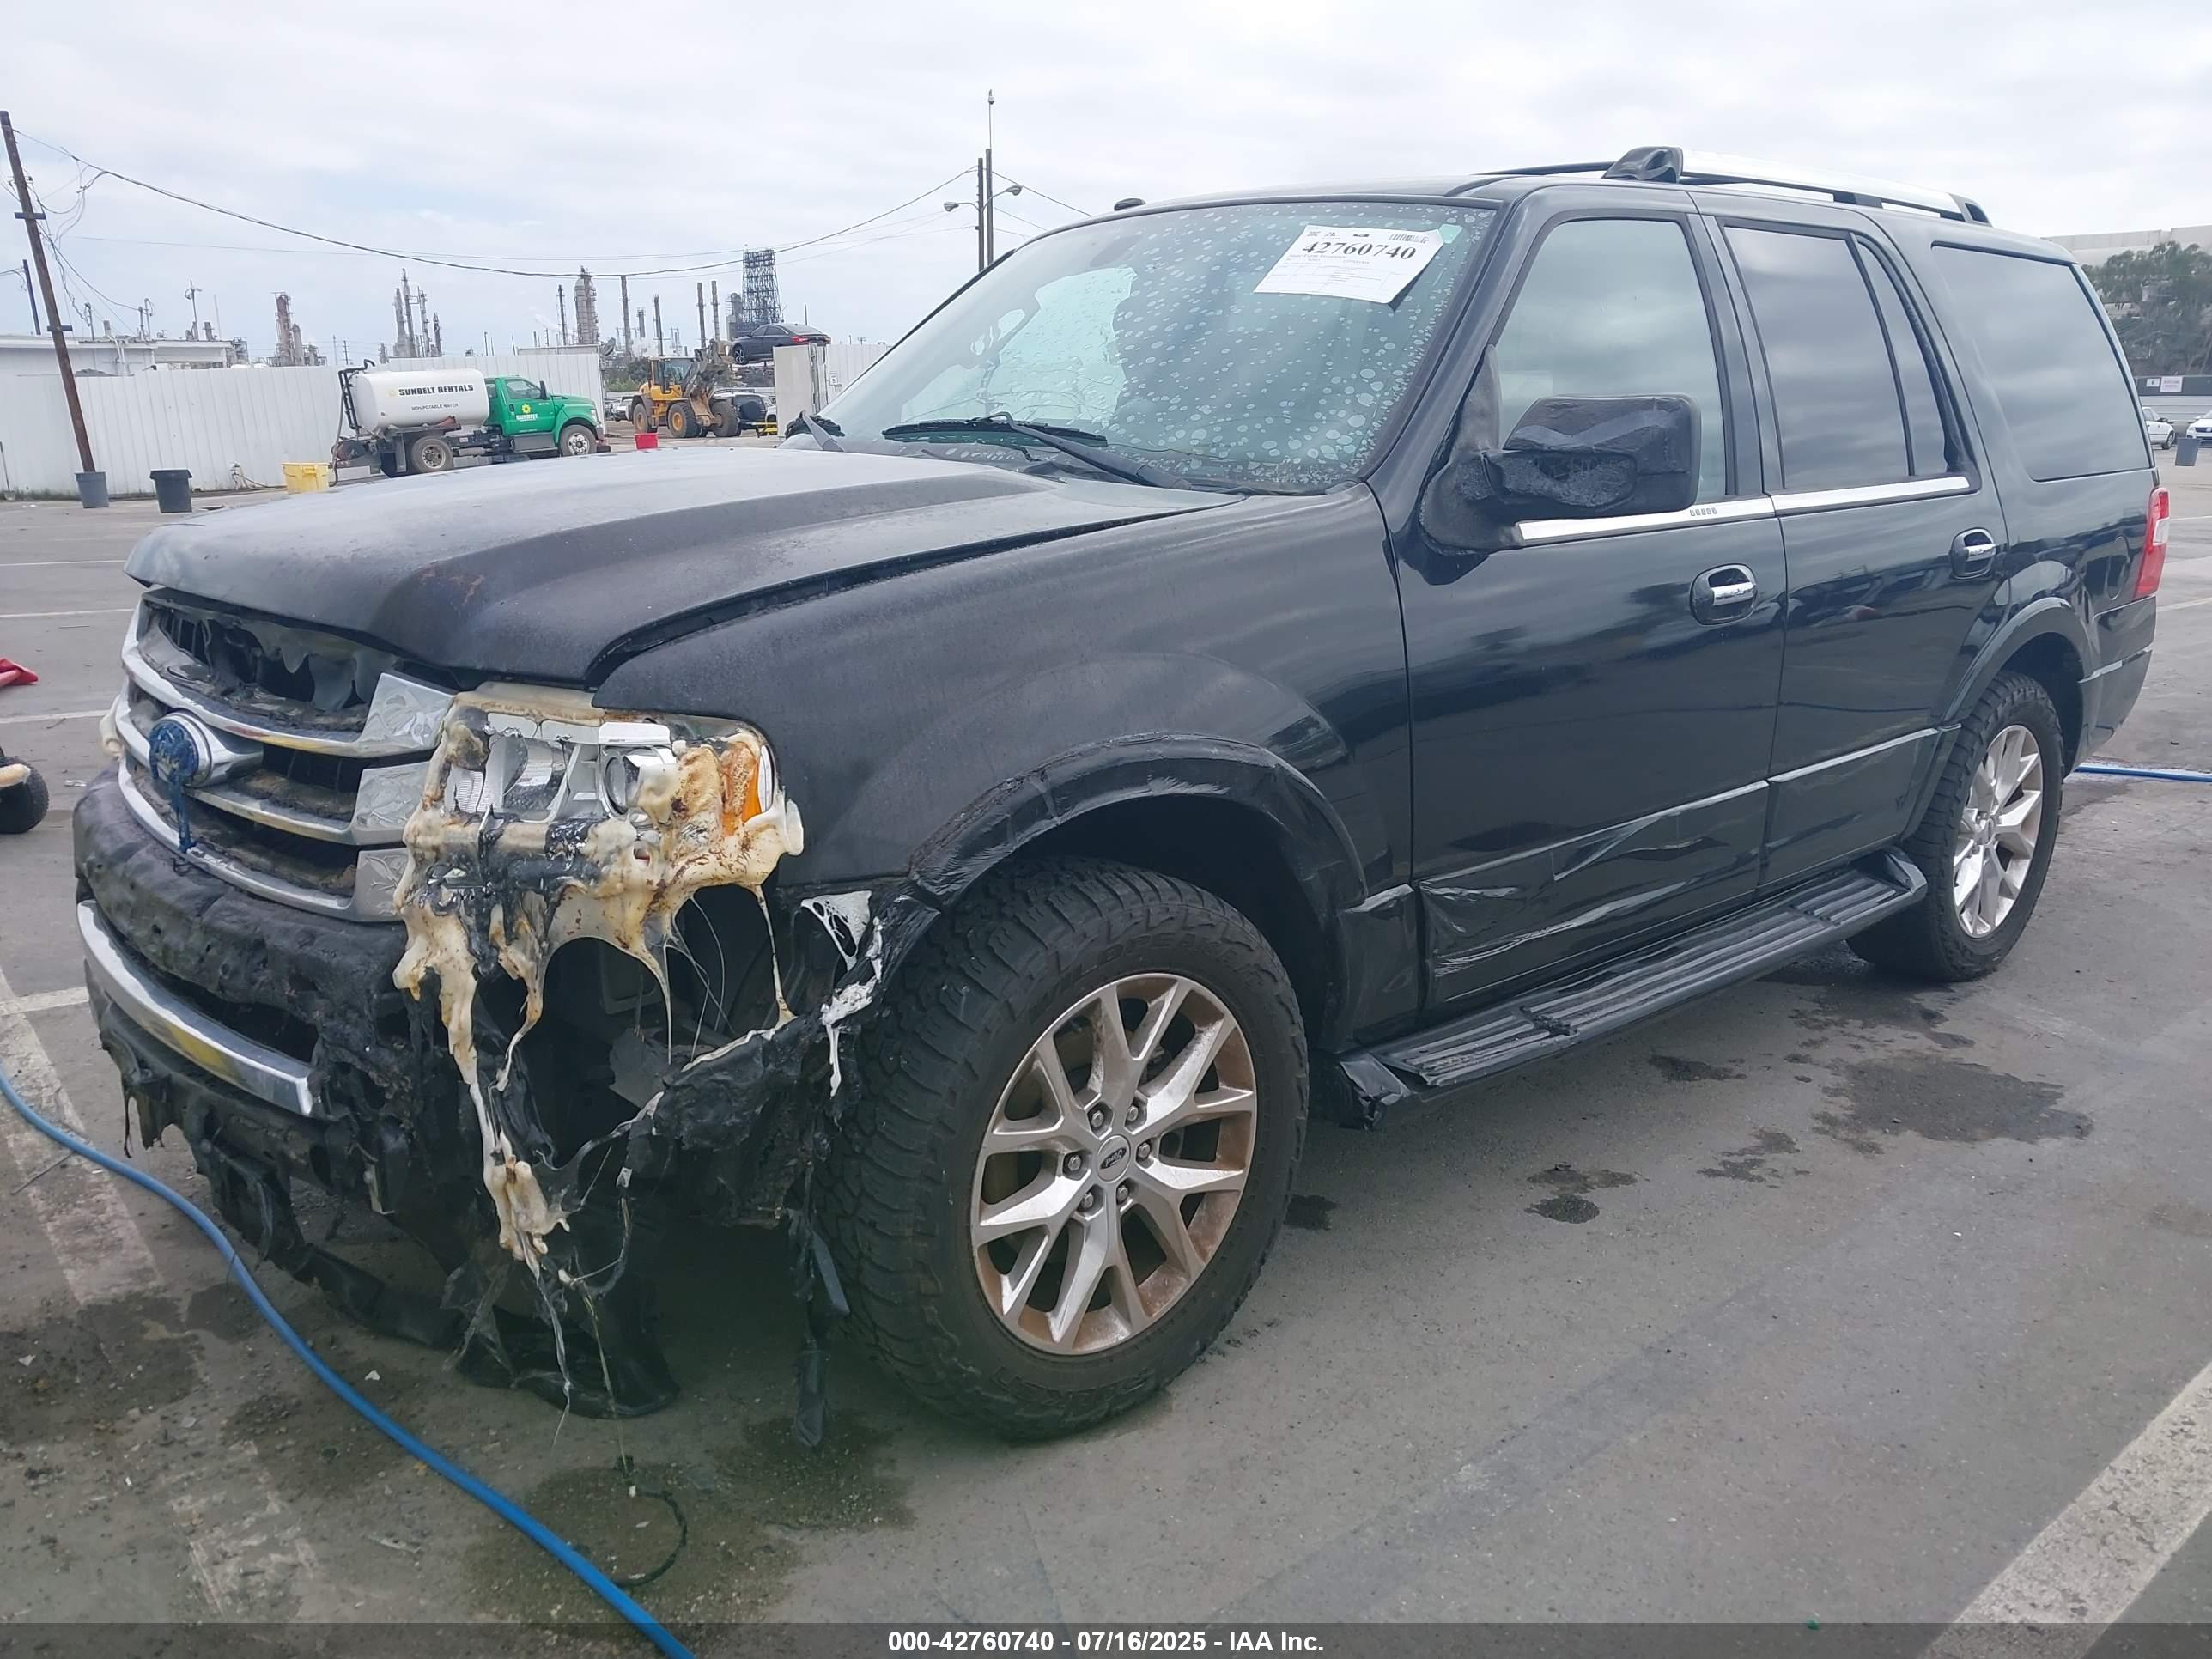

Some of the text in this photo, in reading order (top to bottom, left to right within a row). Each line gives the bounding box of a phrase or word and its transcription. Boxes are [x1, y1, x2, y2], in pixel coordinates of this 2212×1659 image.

[1302, 241, 1417, 260] 42760740
[398, 384, 474, 396] SUNBELT RENTALS
